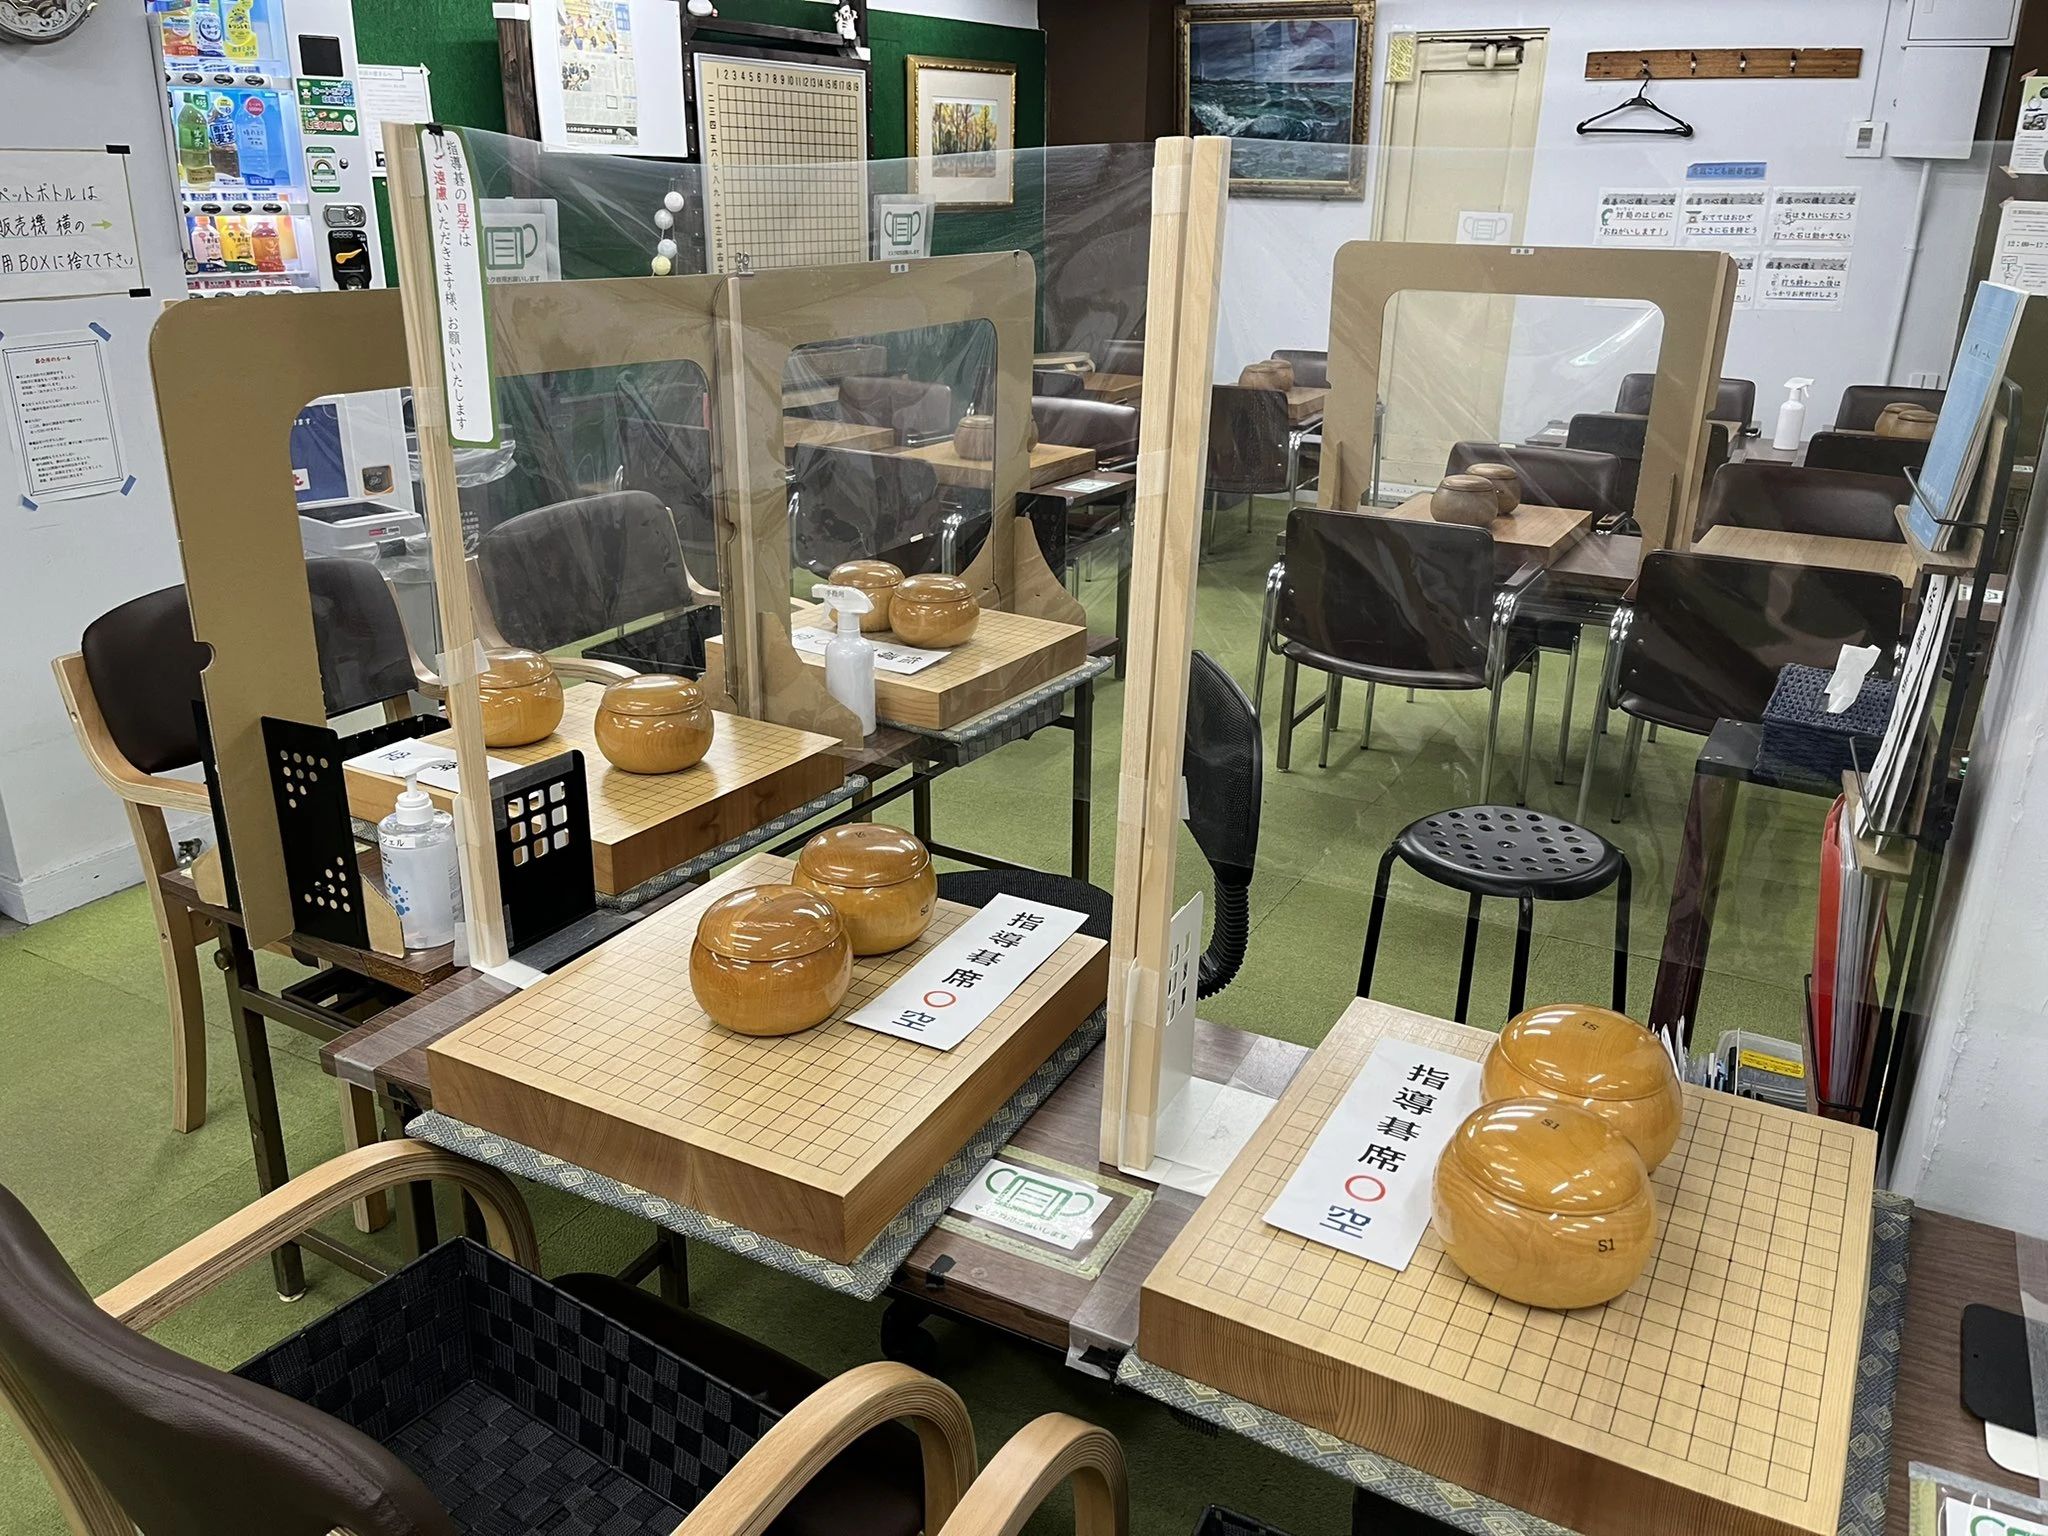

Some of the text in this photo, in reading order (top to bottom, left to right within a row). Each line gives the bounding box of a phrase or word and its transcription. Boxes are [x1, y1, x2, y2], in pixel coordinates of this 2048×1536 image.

[716, 68, 859, 92] 1 2 3 4 5 6 7 8 9 10 11 12 13 14 15 16 17 18 19
[708, 94, 715, 102] 二
[709, 106, 716, 116] 三
[710, 120, 716, 130] 四
[710, 134, 717, 144] 五
[711, 149, 718, 157] 六
[712, 162, 719, 171] 七
[713, 175, 720, 184] 八
[713, 189, 720, 197] 九
[1615, 210, 1673, 219] 対局のはじめに
[1702, 213, 1753, 222] おててはおひざ
[1785, 211, 1852, 221] 石はきれいにおこう
[1772, 231, 1851, 240] 打った石は動かさない
[891, 911, 1046, 1032] 指導碁席 空
[1540, 1117, 1560, 1132] S1
[1319, 1063, 1450, 1239] 指導碁席 空
[1597, 1237, 1616, 1254] S1
